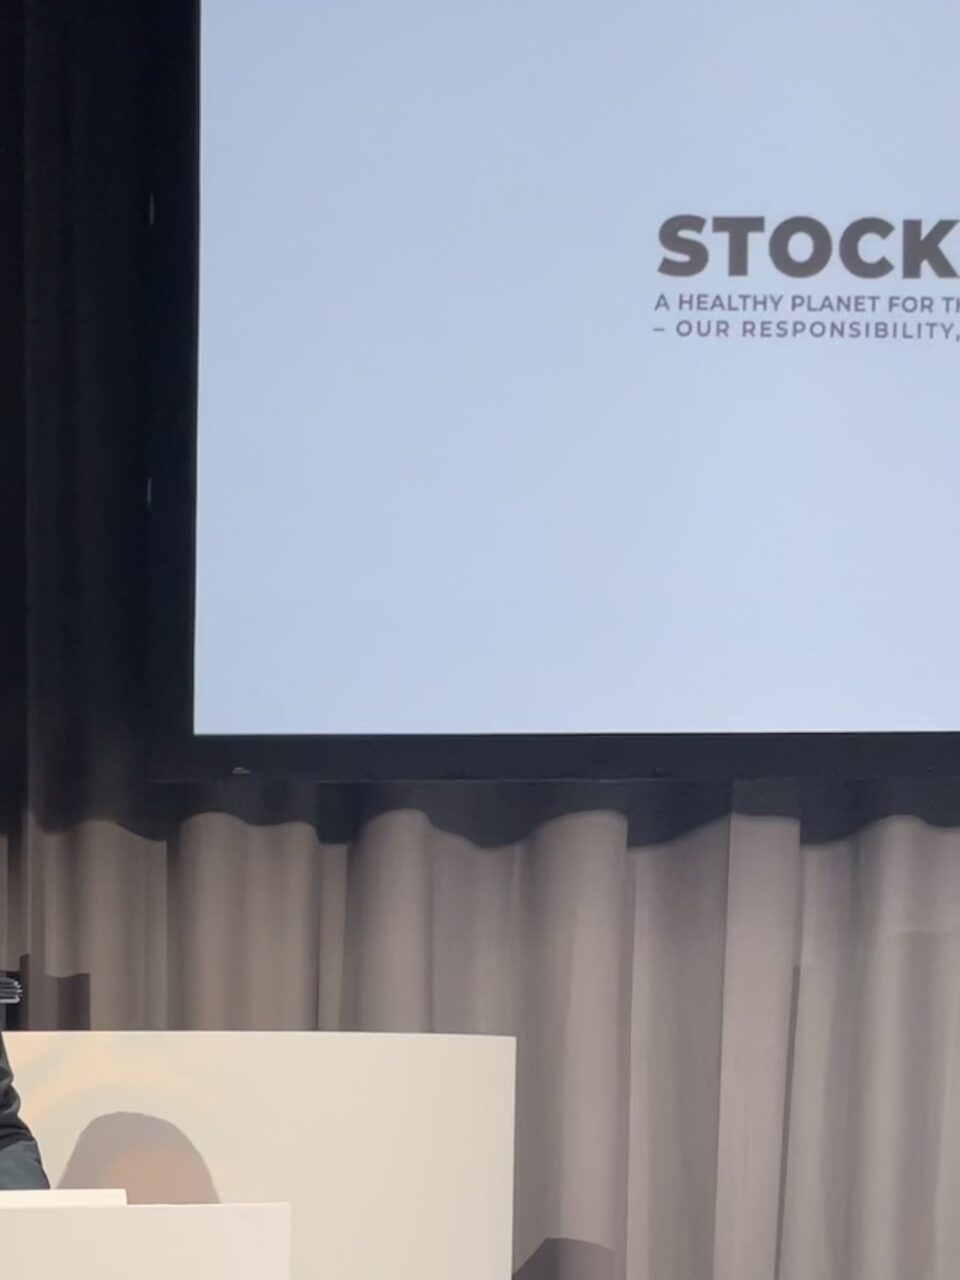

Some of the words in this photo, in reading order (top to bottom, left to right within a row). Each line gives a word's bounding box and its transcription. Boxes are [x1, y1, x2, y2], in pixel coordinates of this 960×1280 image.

[657, 214, 960, 279] STOCK
[654, 294, 670, 311] A
[678, 294, 784, 312] HEALTHY
[790, 295, 881, 313] PLANET
[888, 296, 934, 313] FOR
[675, 320, 730, 338] OUR
